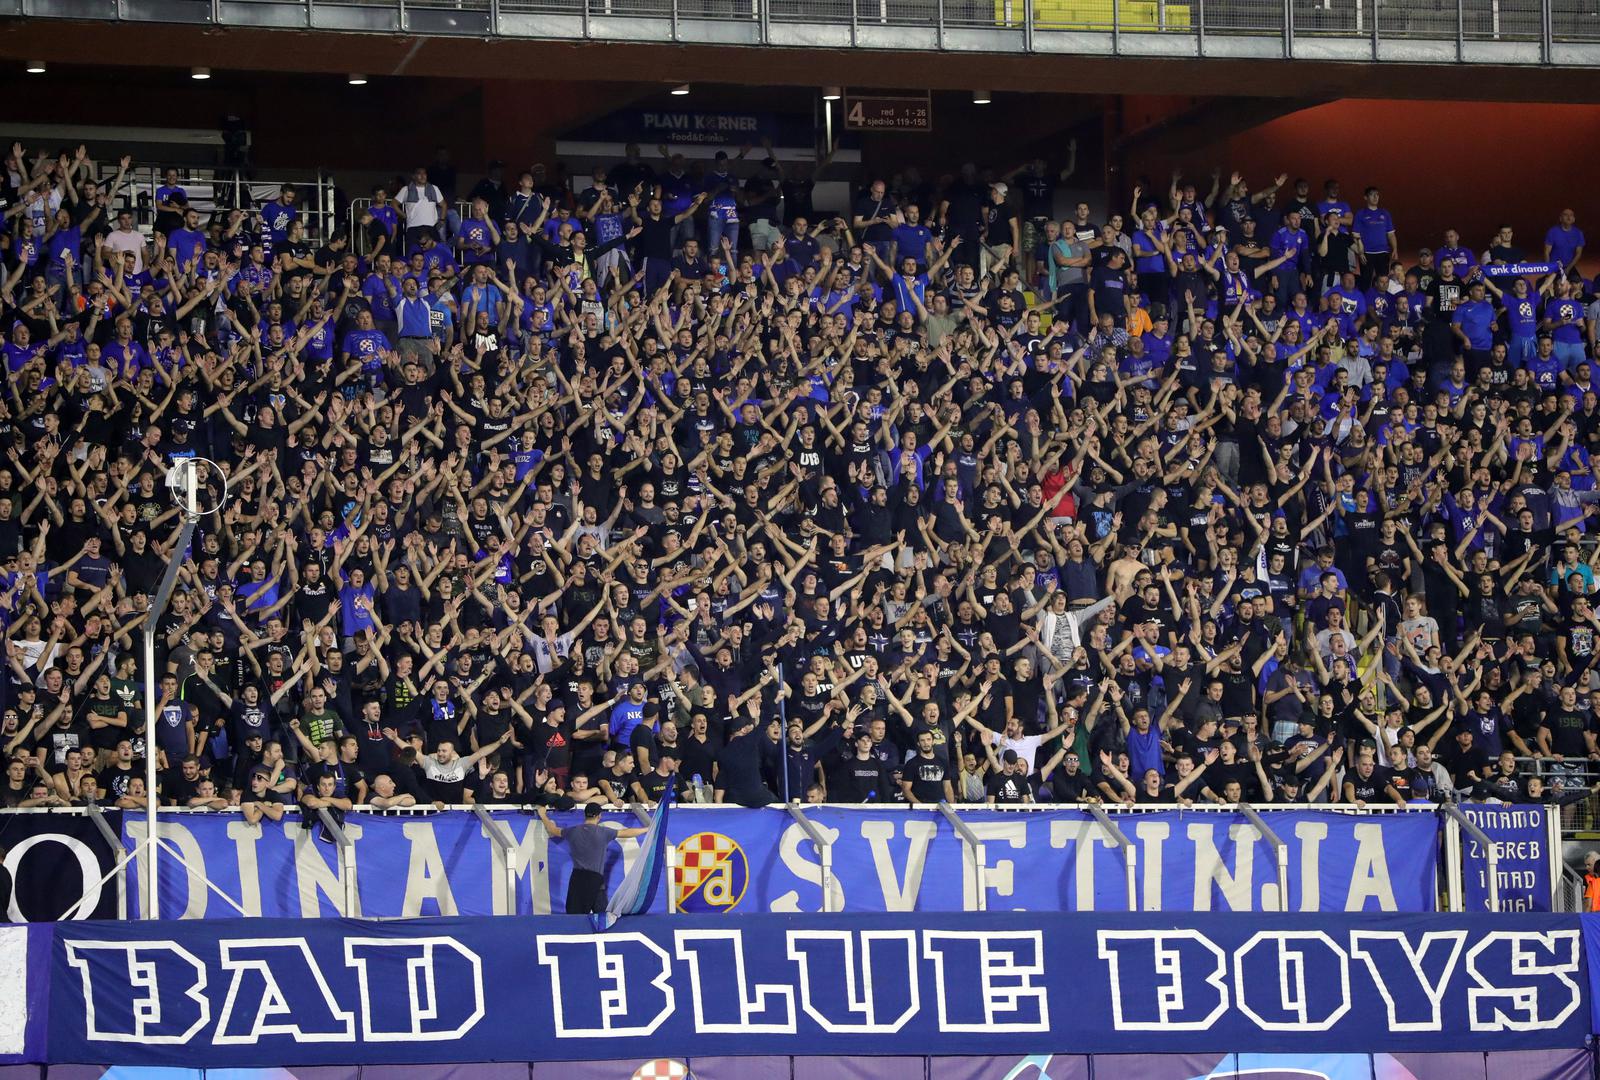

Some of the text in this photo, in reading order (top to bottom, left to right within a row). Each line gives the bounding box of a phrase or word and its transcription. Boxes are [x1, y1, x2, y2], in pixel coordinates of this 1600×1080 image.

[642, 113, 689, 129] PLAVI
[848, 101, 866, 127] 4
[1490, 265, 1509, 275] gnk
[627, 711, 642, 720] NK
[1465, 810, 1540, 829] DINAMO
[1470, 841, 1540, 860] ZGREB
[769, 820, 1398, 912] SVETINJA
[1479, 870, 1536, 889] INAD
[64, 929, 1581, 1045] BAD BLUE BOYS
